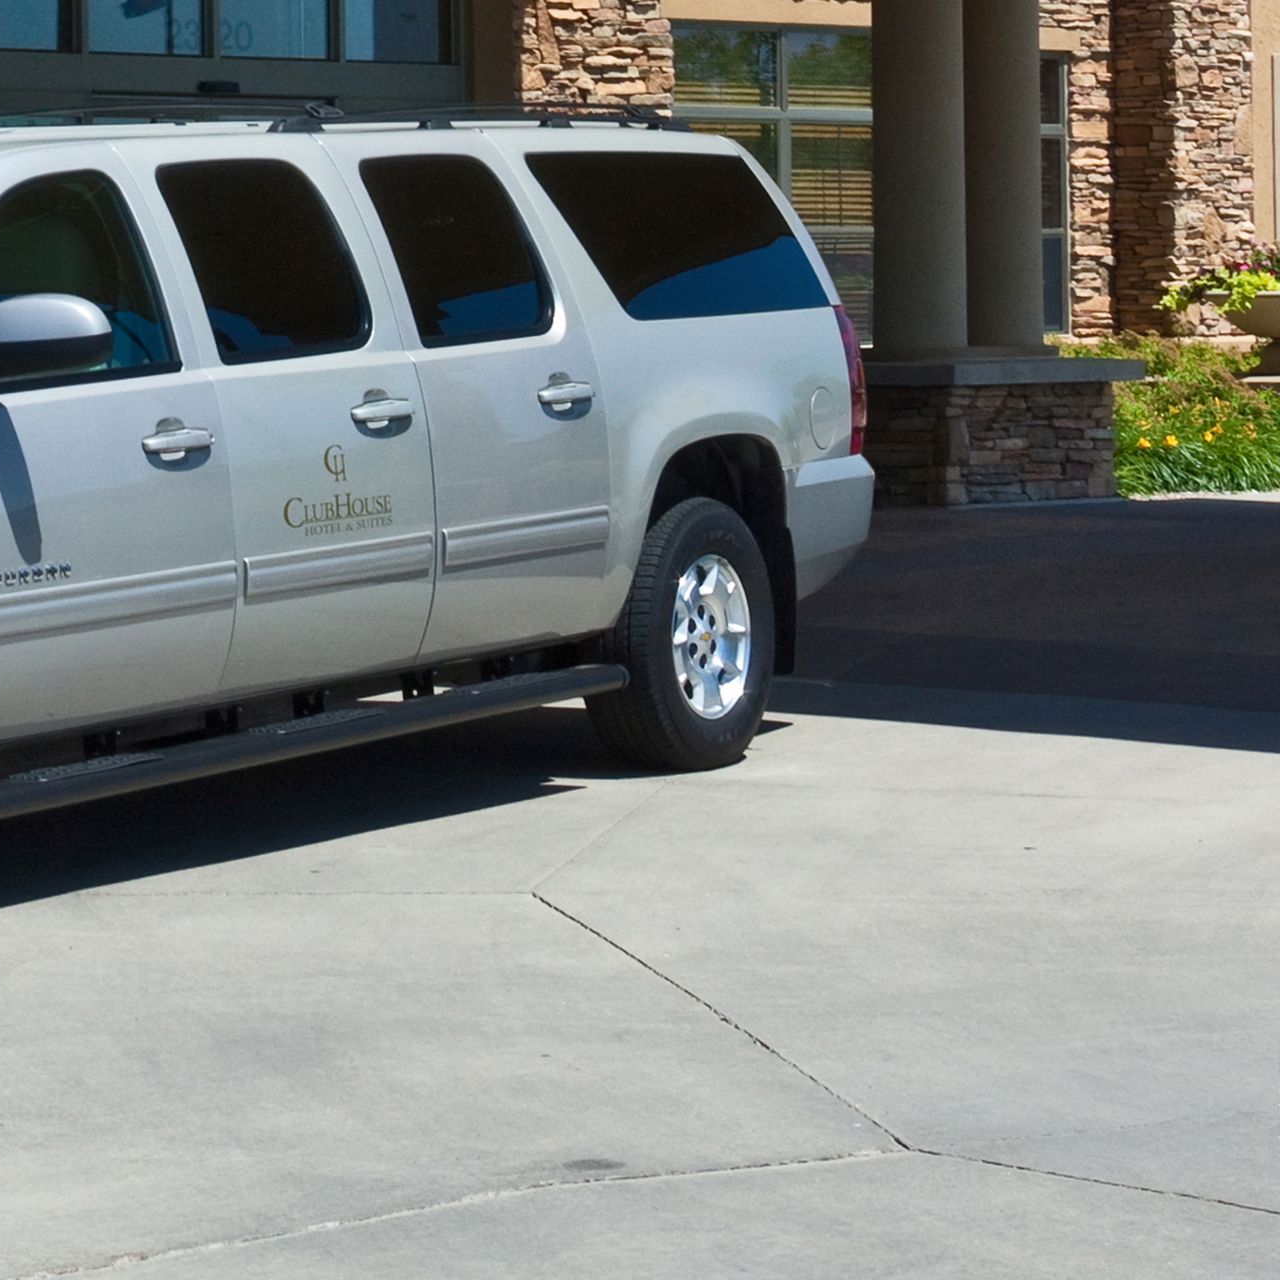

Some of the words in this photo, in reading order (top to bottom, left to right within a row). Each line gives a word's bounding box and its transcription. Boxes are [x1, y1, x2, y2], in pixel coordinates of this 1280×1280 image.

[283, 492, 393, 528] CLUBHOUSE
[304, 522, 342, 537] HOTEL
[345, 523, 354, 531] &
[356, 516, 393, 530] SUITES
